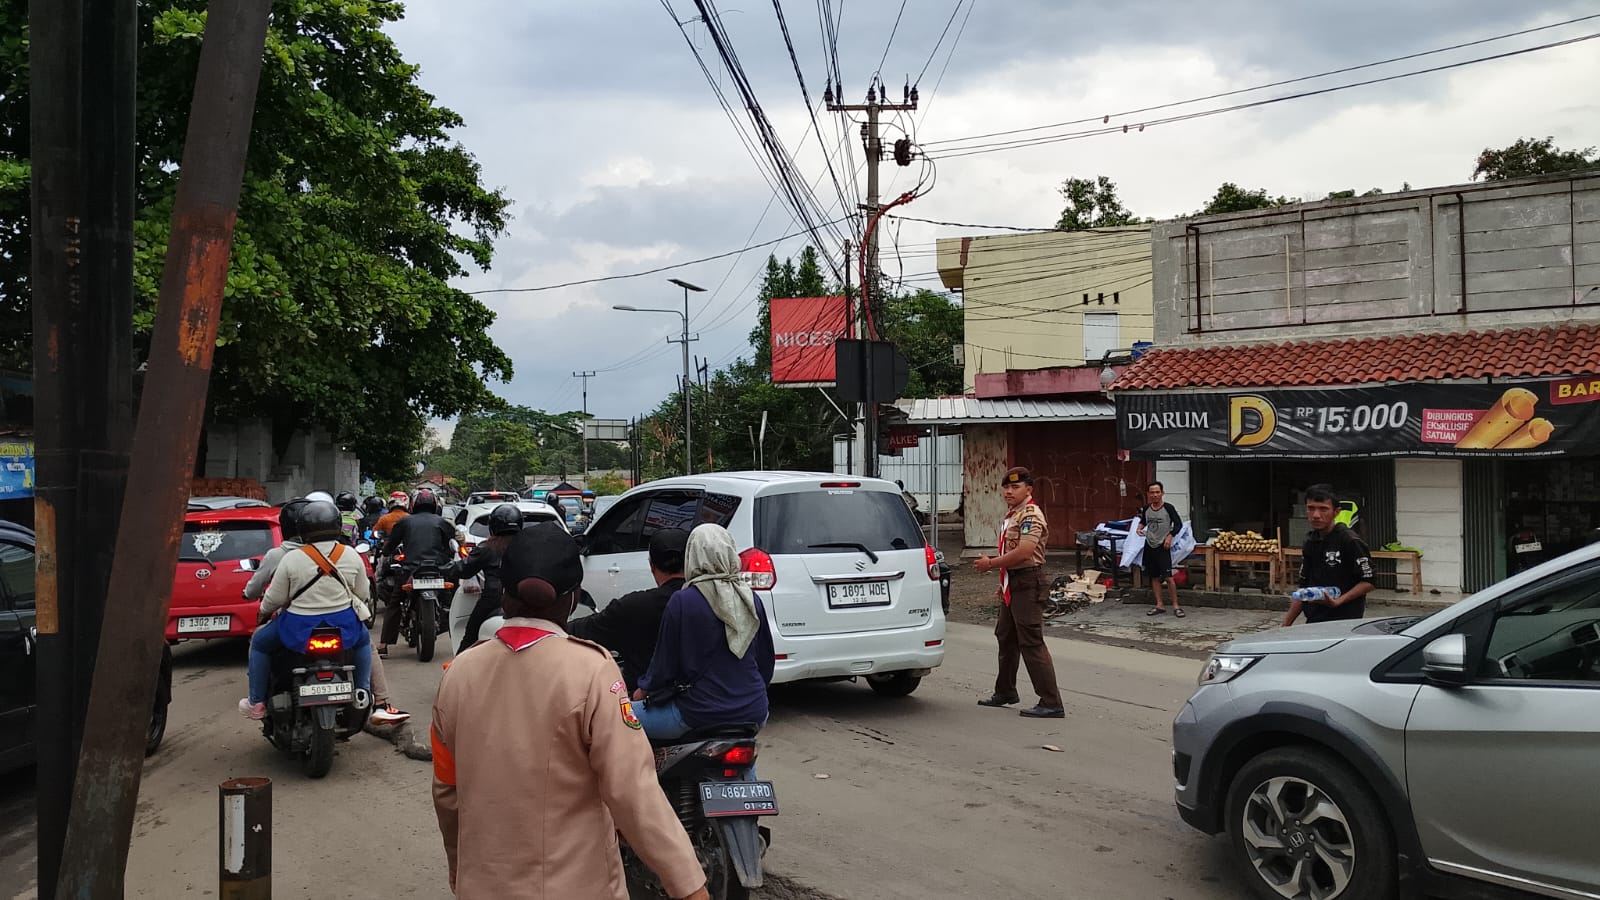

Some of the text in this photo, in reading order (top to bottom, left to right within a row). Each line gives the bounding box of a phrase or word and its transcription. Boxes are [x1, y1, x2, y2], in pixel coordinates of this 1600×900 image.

[1127, 411, 1209, 431] DJARUM
[1229, 395, 1279, 447] D
[1297, 401, 1408, 433] RP 15.000
[1426, 411, 1474, 421] DIBUNGKUS
[1426, 421, 1470, 431] EKSKLUSIF
[889, 435, 918, 445] ALKES
[1425, 430, 1457, 441] SATUAN
[830, 585, 838, 598] B
[842, 584, 866, 597] 1891
[704, 785, 771, 799] B 4862 KRD
